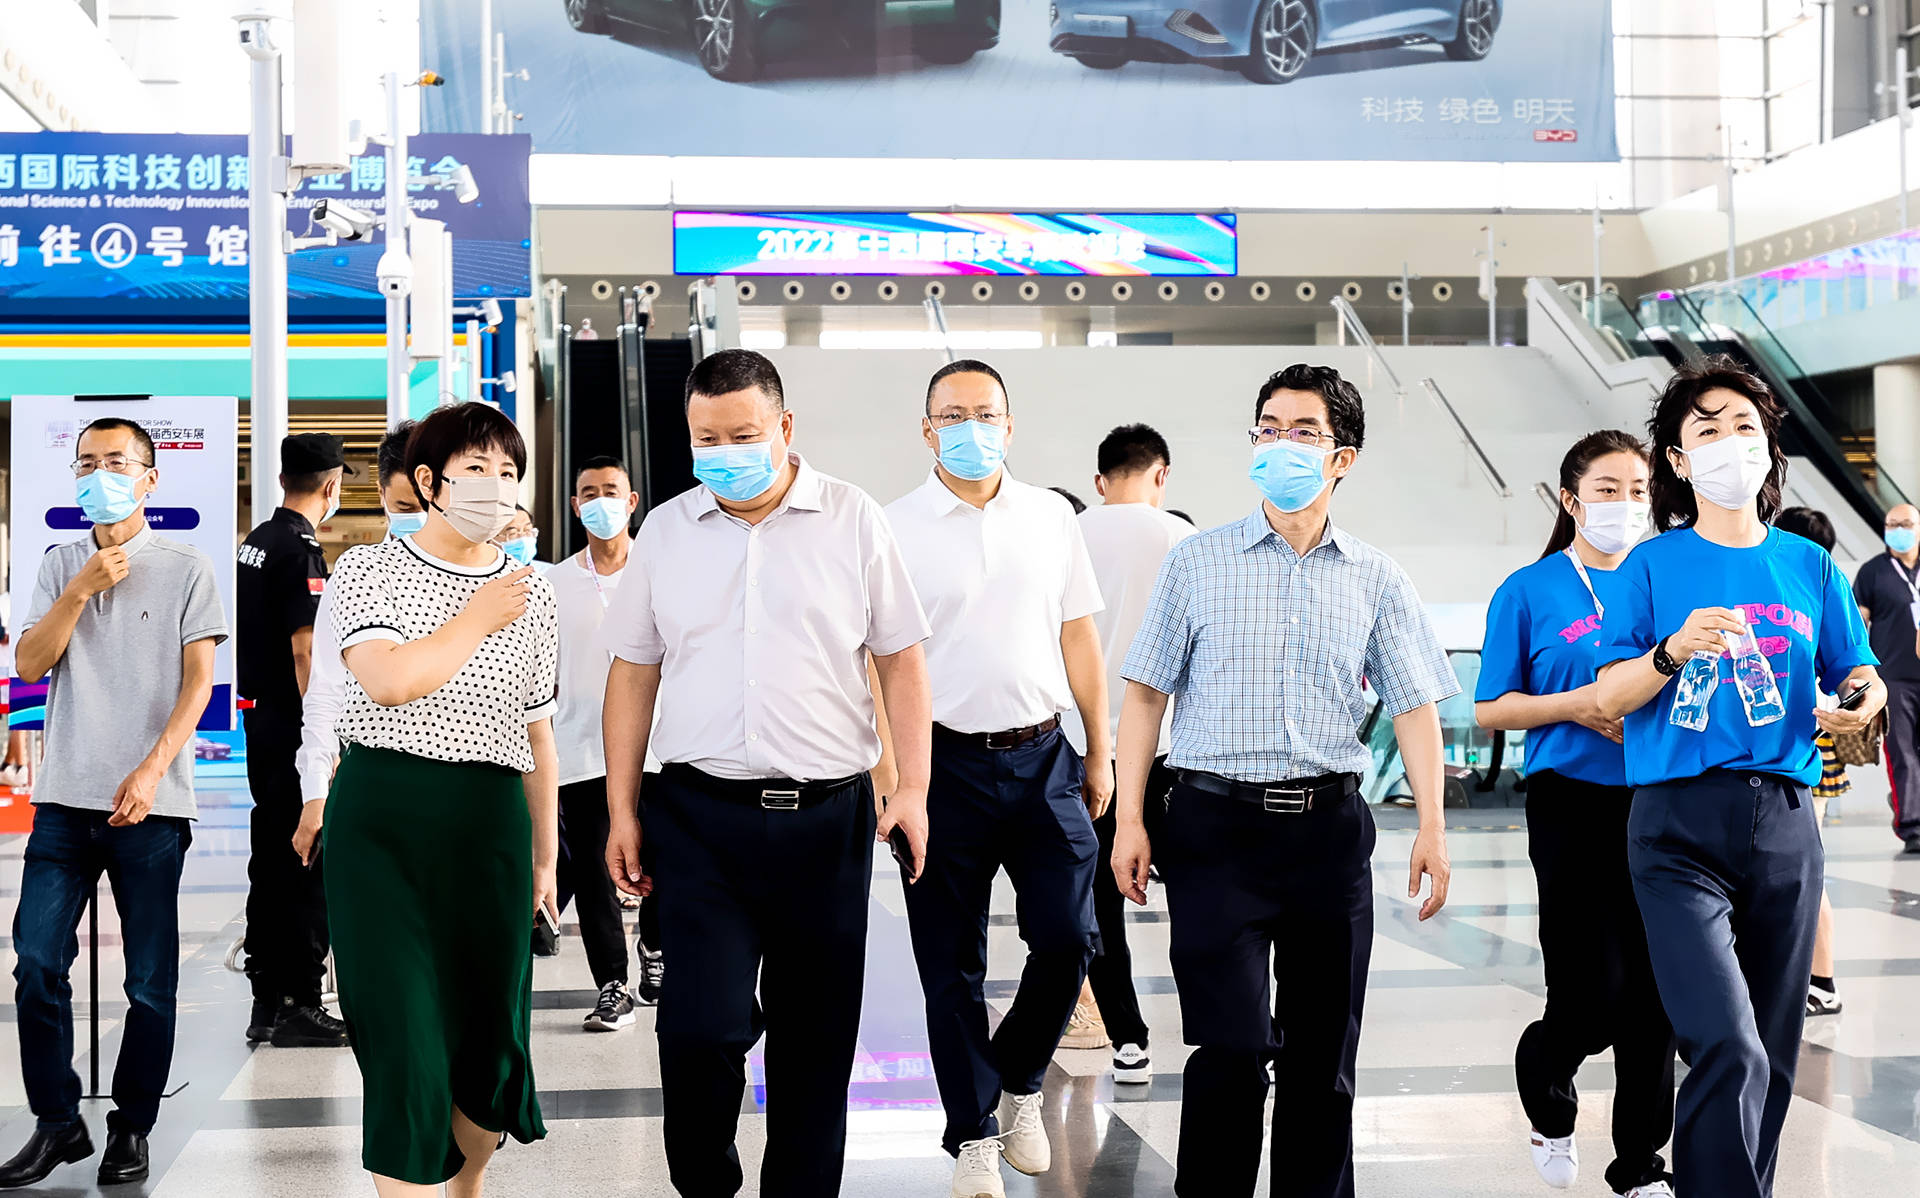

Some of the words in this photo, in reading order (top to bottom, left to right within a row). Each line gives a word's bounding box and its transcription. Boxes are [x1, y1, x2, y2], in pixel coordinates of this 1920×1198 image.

[1360, 97, 1425, 123] 科技
[1438, 97, 1502, 124] 绿色
[1513, 98, 1576, 124] 明天
[30, 194, 87, 208] Science
[89, 194, 101, 208] &
[104, 194, 184, 211] Technology
